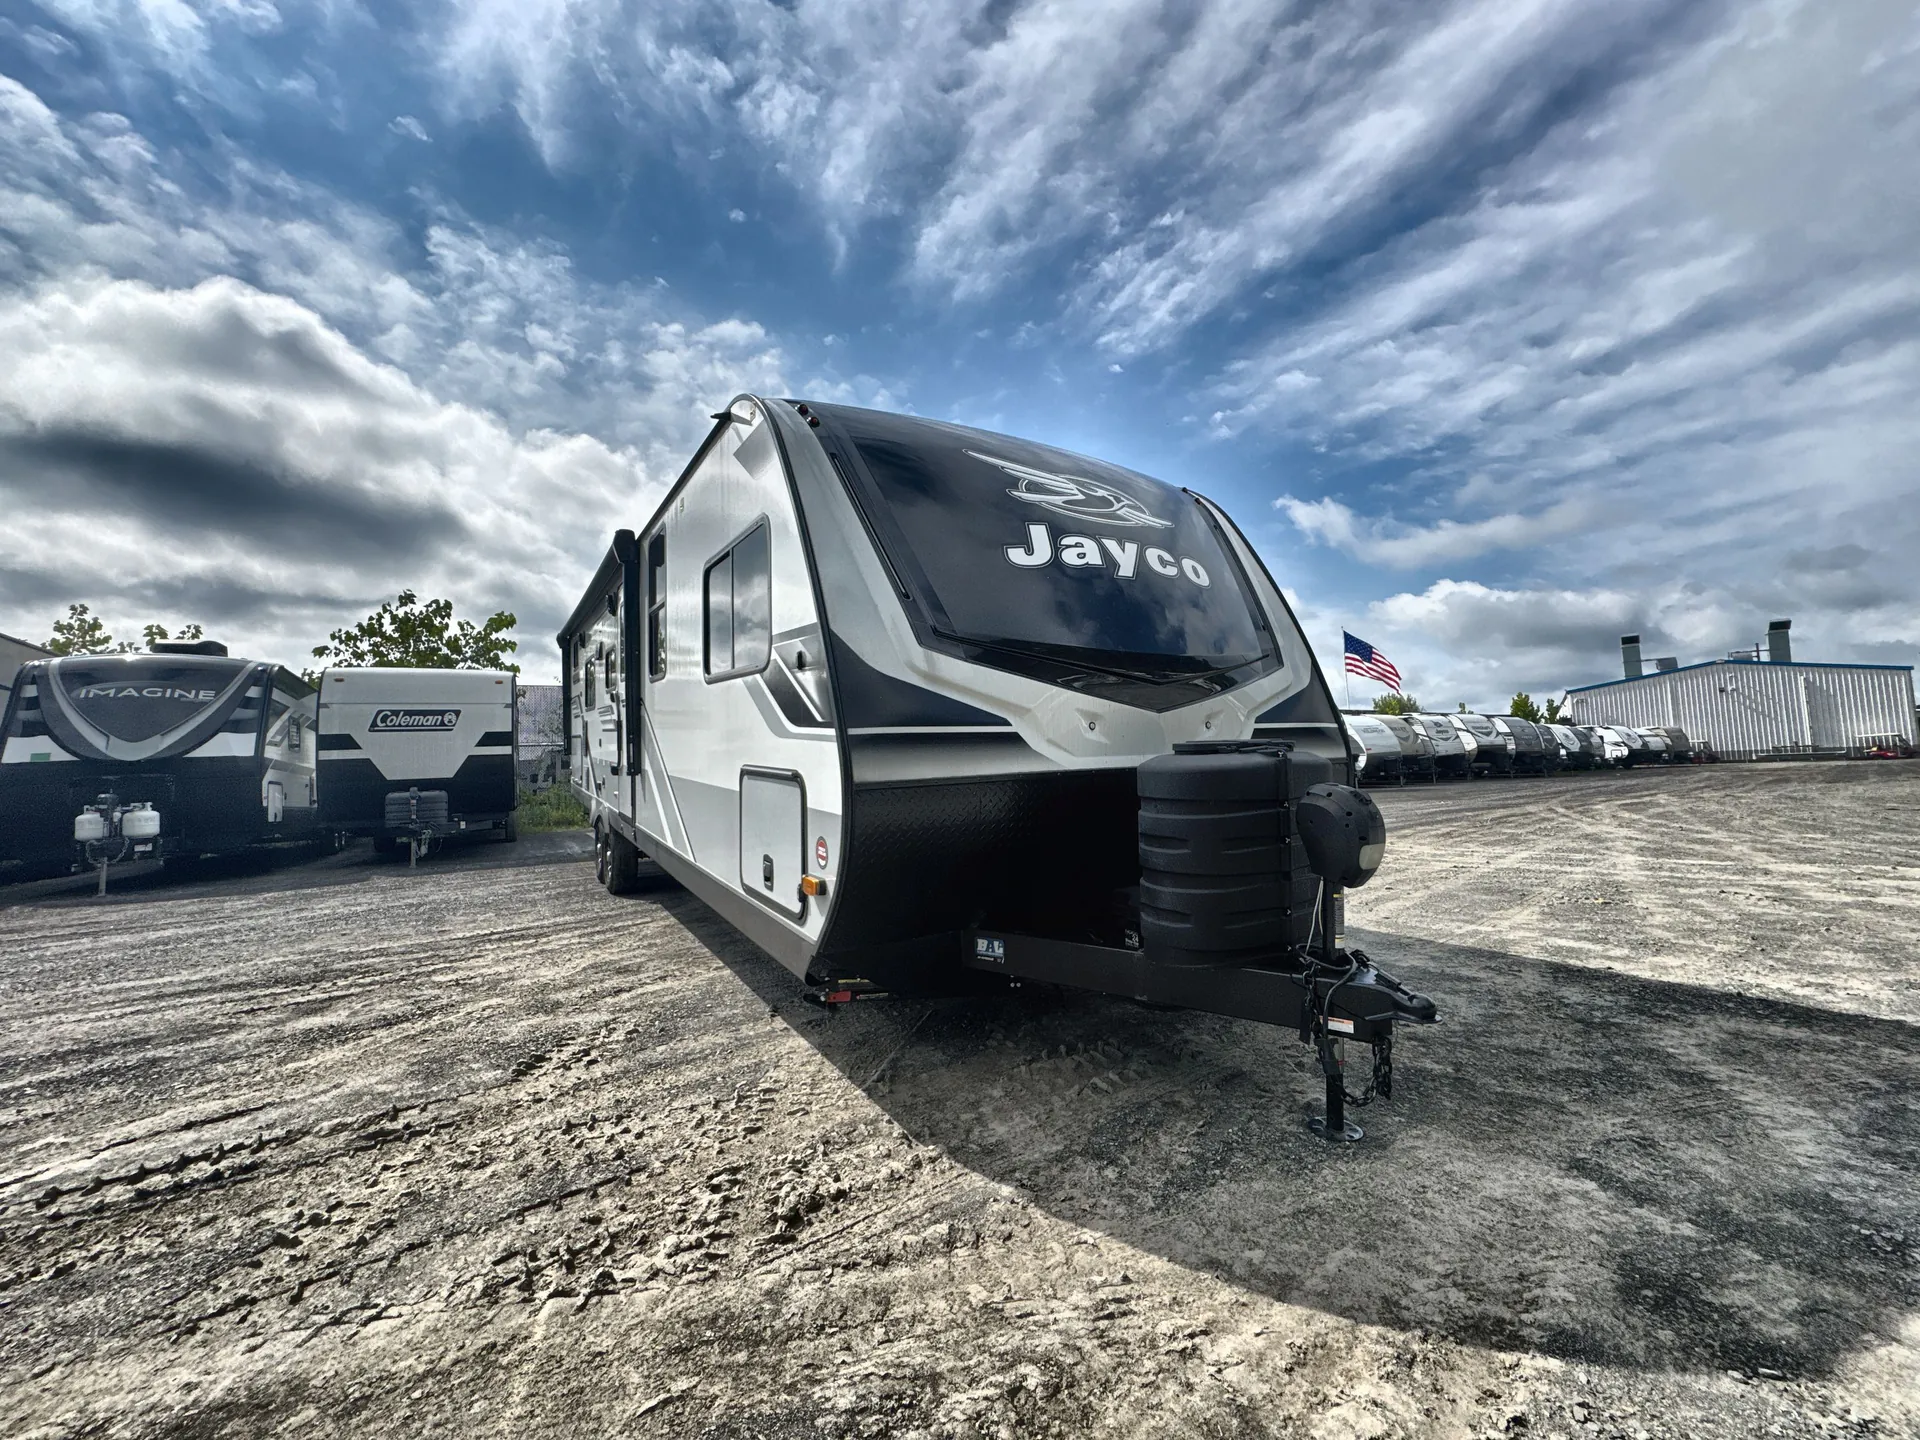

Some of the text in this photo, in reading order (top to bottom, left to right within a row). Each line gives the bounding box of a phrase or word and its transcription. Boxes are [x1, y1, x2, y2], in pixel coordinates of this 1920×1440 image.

[1004, 522, 1212, 588] Jayco
[79, 687, 216, 700] IMAGINE
[376, 711, 442, 727] Coleman
